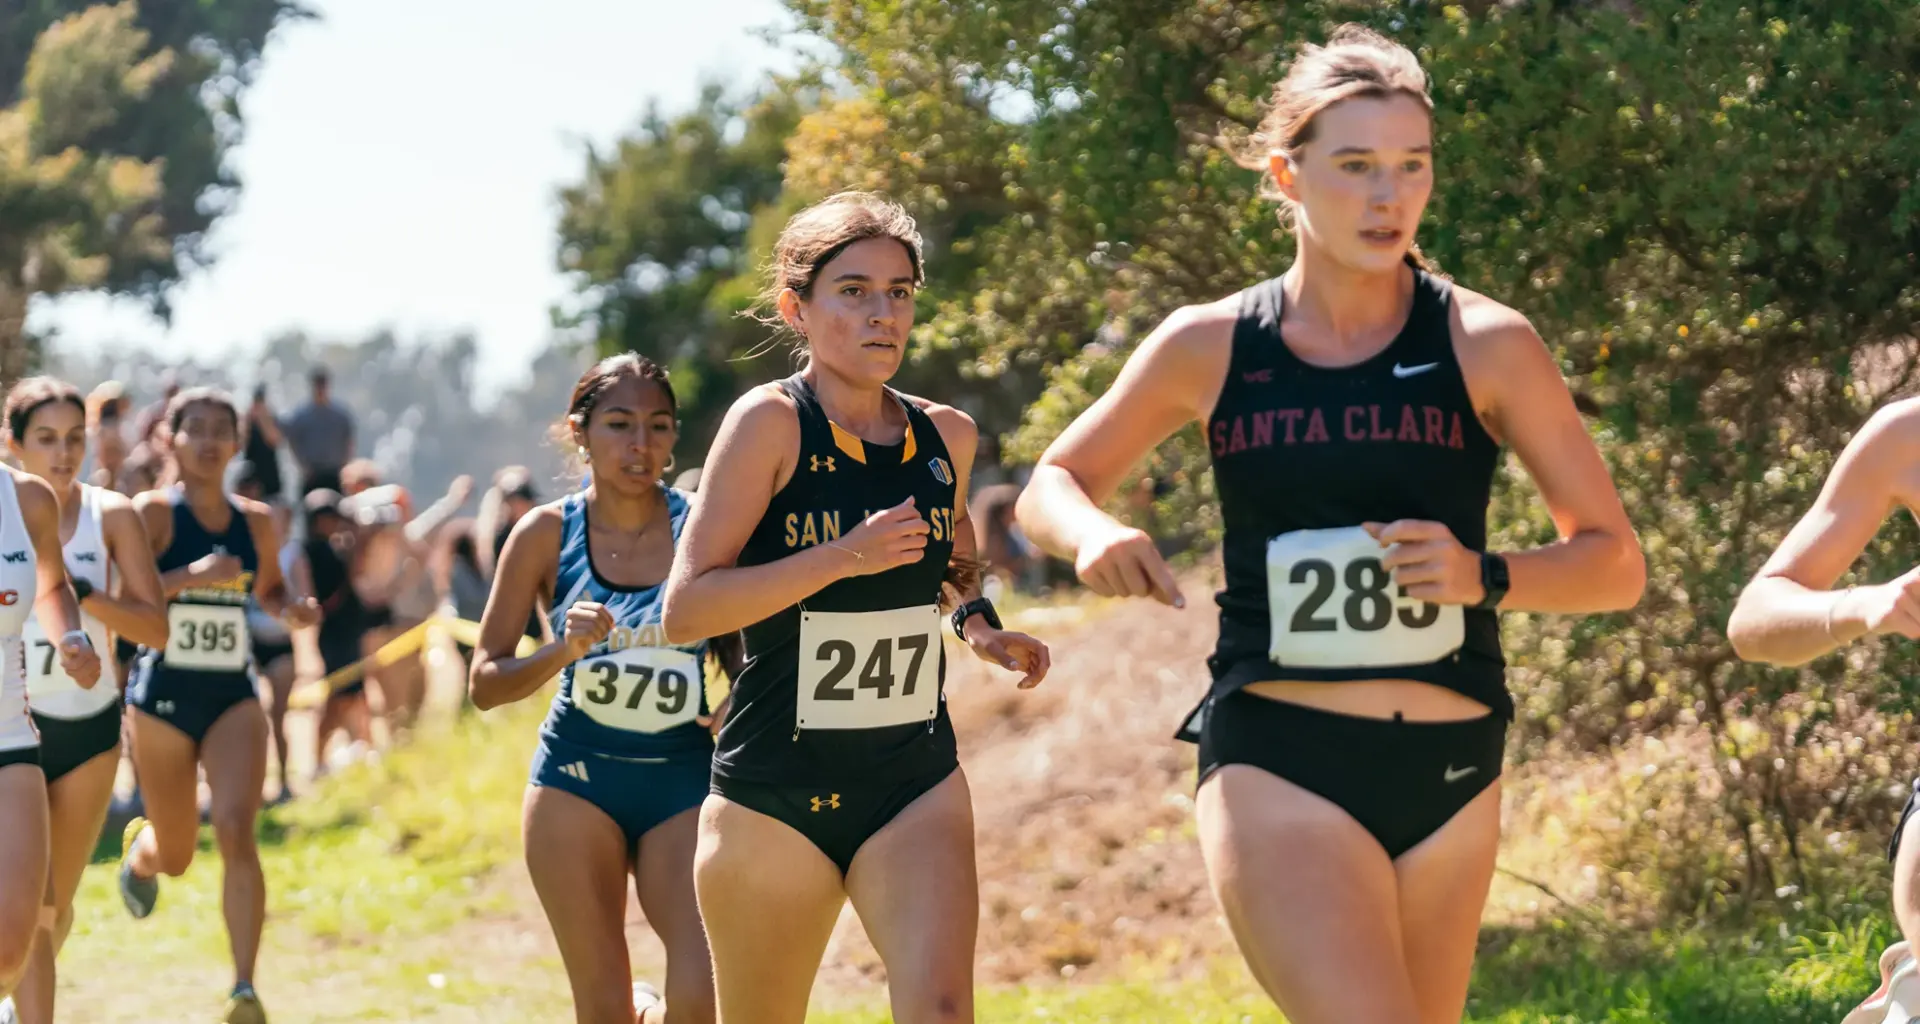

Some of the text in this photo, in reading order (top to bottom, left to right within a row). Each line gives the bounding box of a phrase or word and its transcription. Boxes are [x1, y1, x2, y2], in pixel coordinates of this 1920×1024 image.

[1213, 404, 1465, 457] SANTA CLARA
[785, 510, 840, 548] SAN
[177, 620, 238, 652] 395
[585, 659, 689, 715] 379
[813, 633, 929, 701] 247
